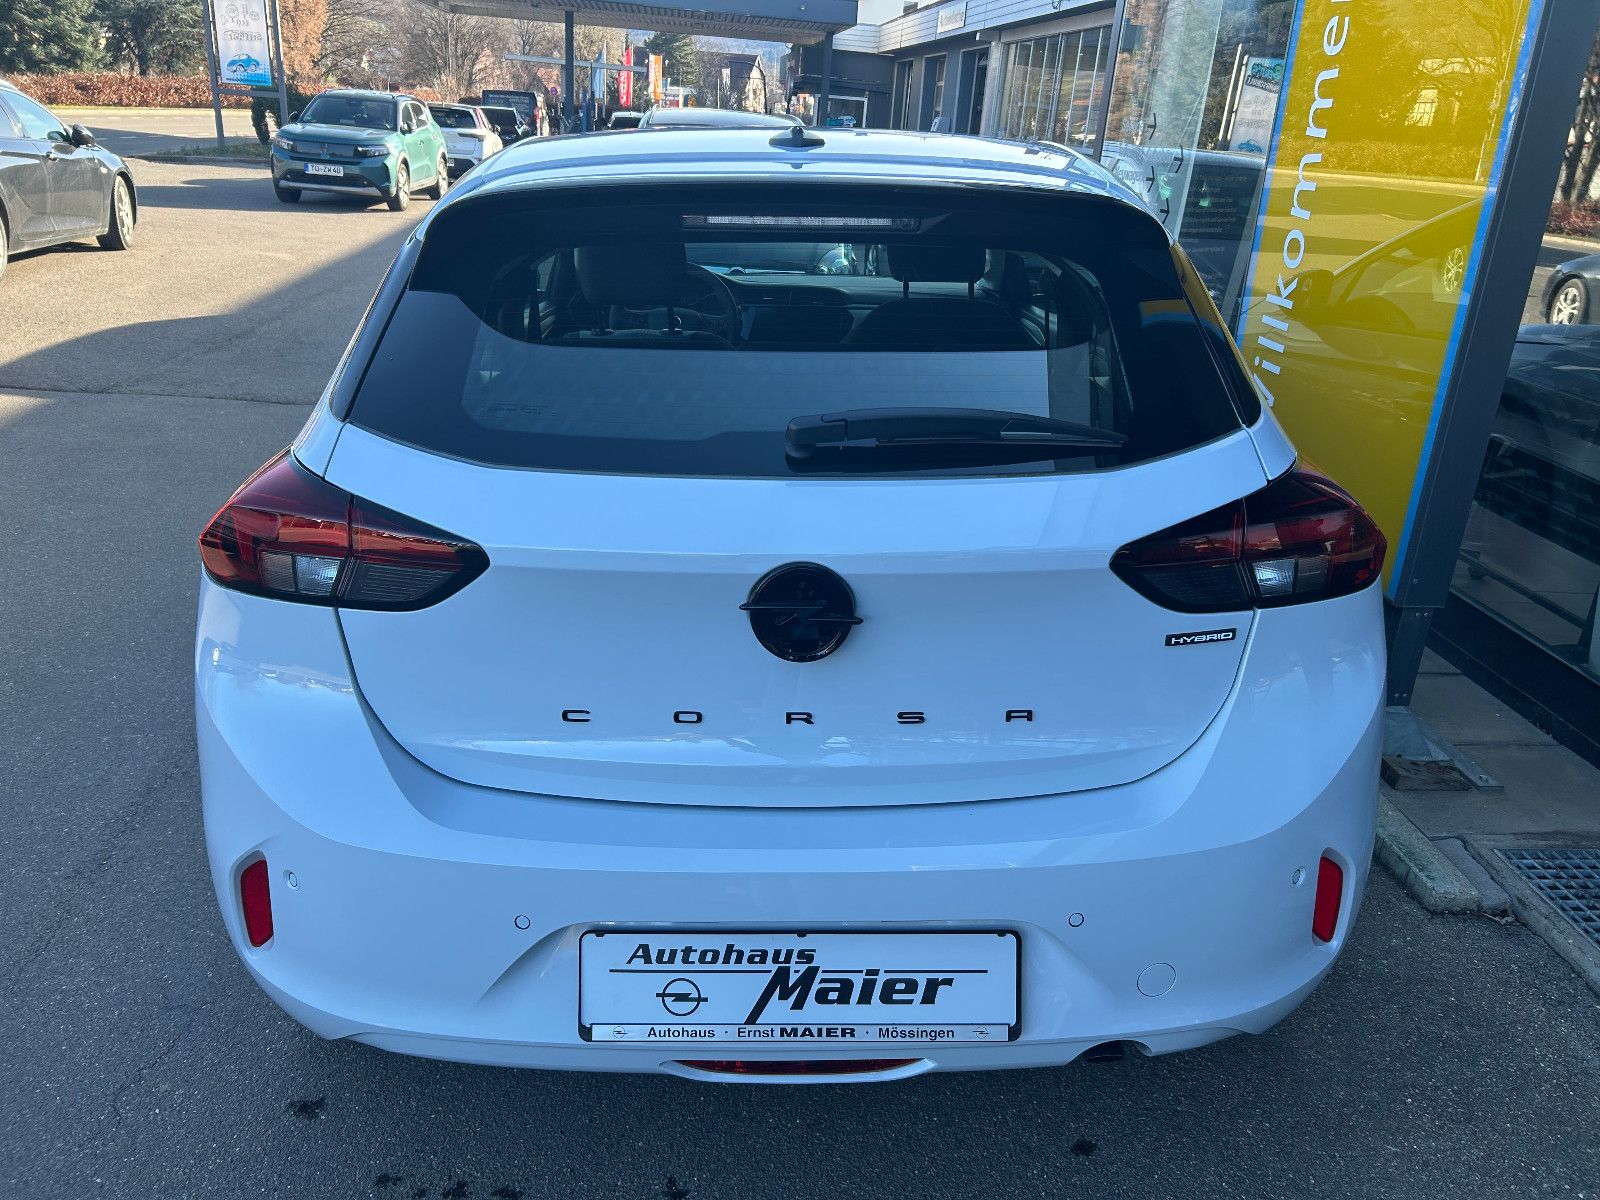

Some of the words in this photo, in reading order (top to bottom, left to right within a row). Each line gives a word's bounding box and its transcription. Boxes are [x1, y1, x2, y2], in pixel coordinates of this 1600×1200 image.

[1252, 0, 1353, 407] illkomme
[1170, 632, 1233, 645] HYBRID
[561, 708, 1034, 725] CORSA
[625, 943, 817, 965] Autohaus
[743, 965, 955, 1025] Maier
[647, 1027, 716, 1038] Autohaus
[737, 1027, 775, 1038] Ernst
[779, 1027, 856, 1038] MAIER
[878, 1026, 955, 1041] Mössingen
